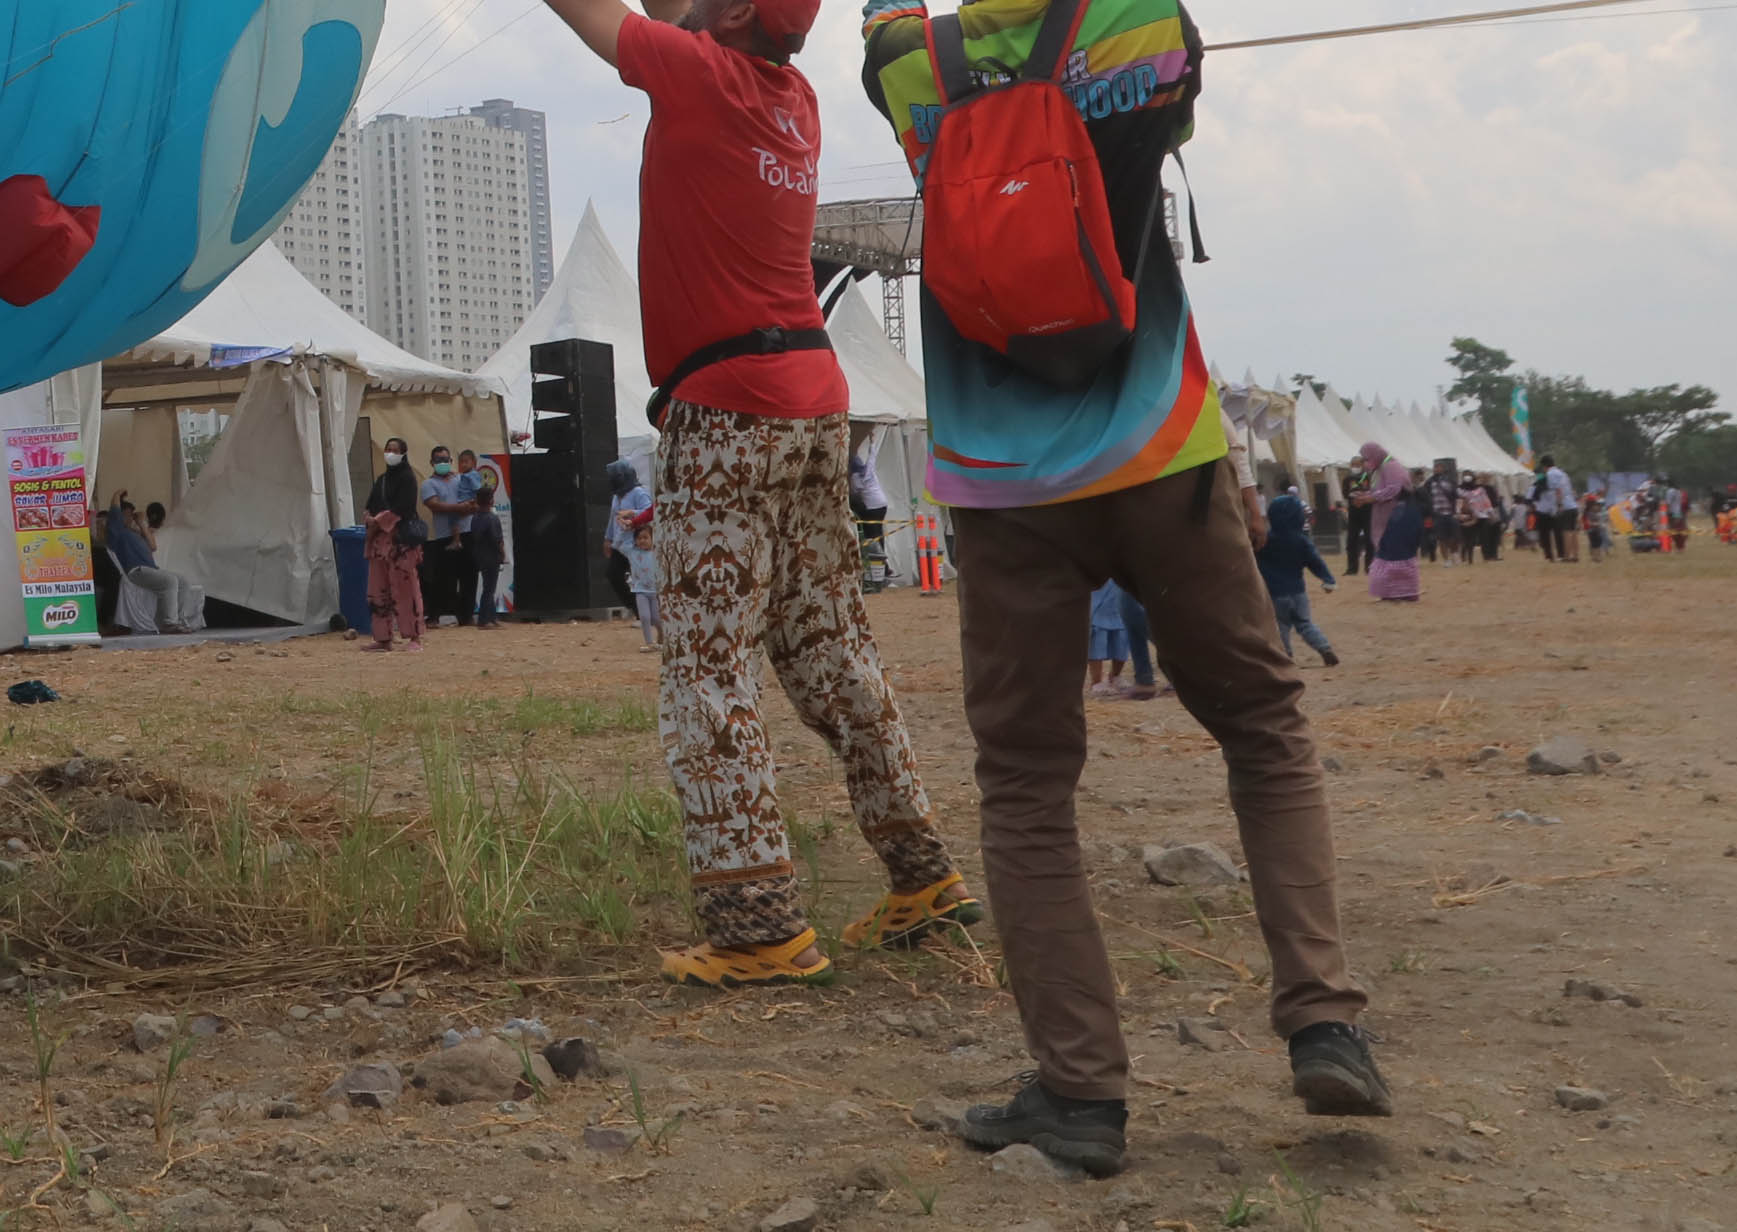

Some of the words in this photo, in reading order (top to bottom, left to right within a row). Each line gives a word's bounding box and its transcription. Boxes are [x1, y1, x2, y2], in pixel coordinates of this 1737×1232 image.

[14, 482, 40, 492] SOSIS
[42, 480, 49, 490] &
[25, 585, 33, 595] Es
[35, 584, 53, 594] Milo
[55, 582, 91, 594] Malaysia
[46, 610, 76, 622] MILO
